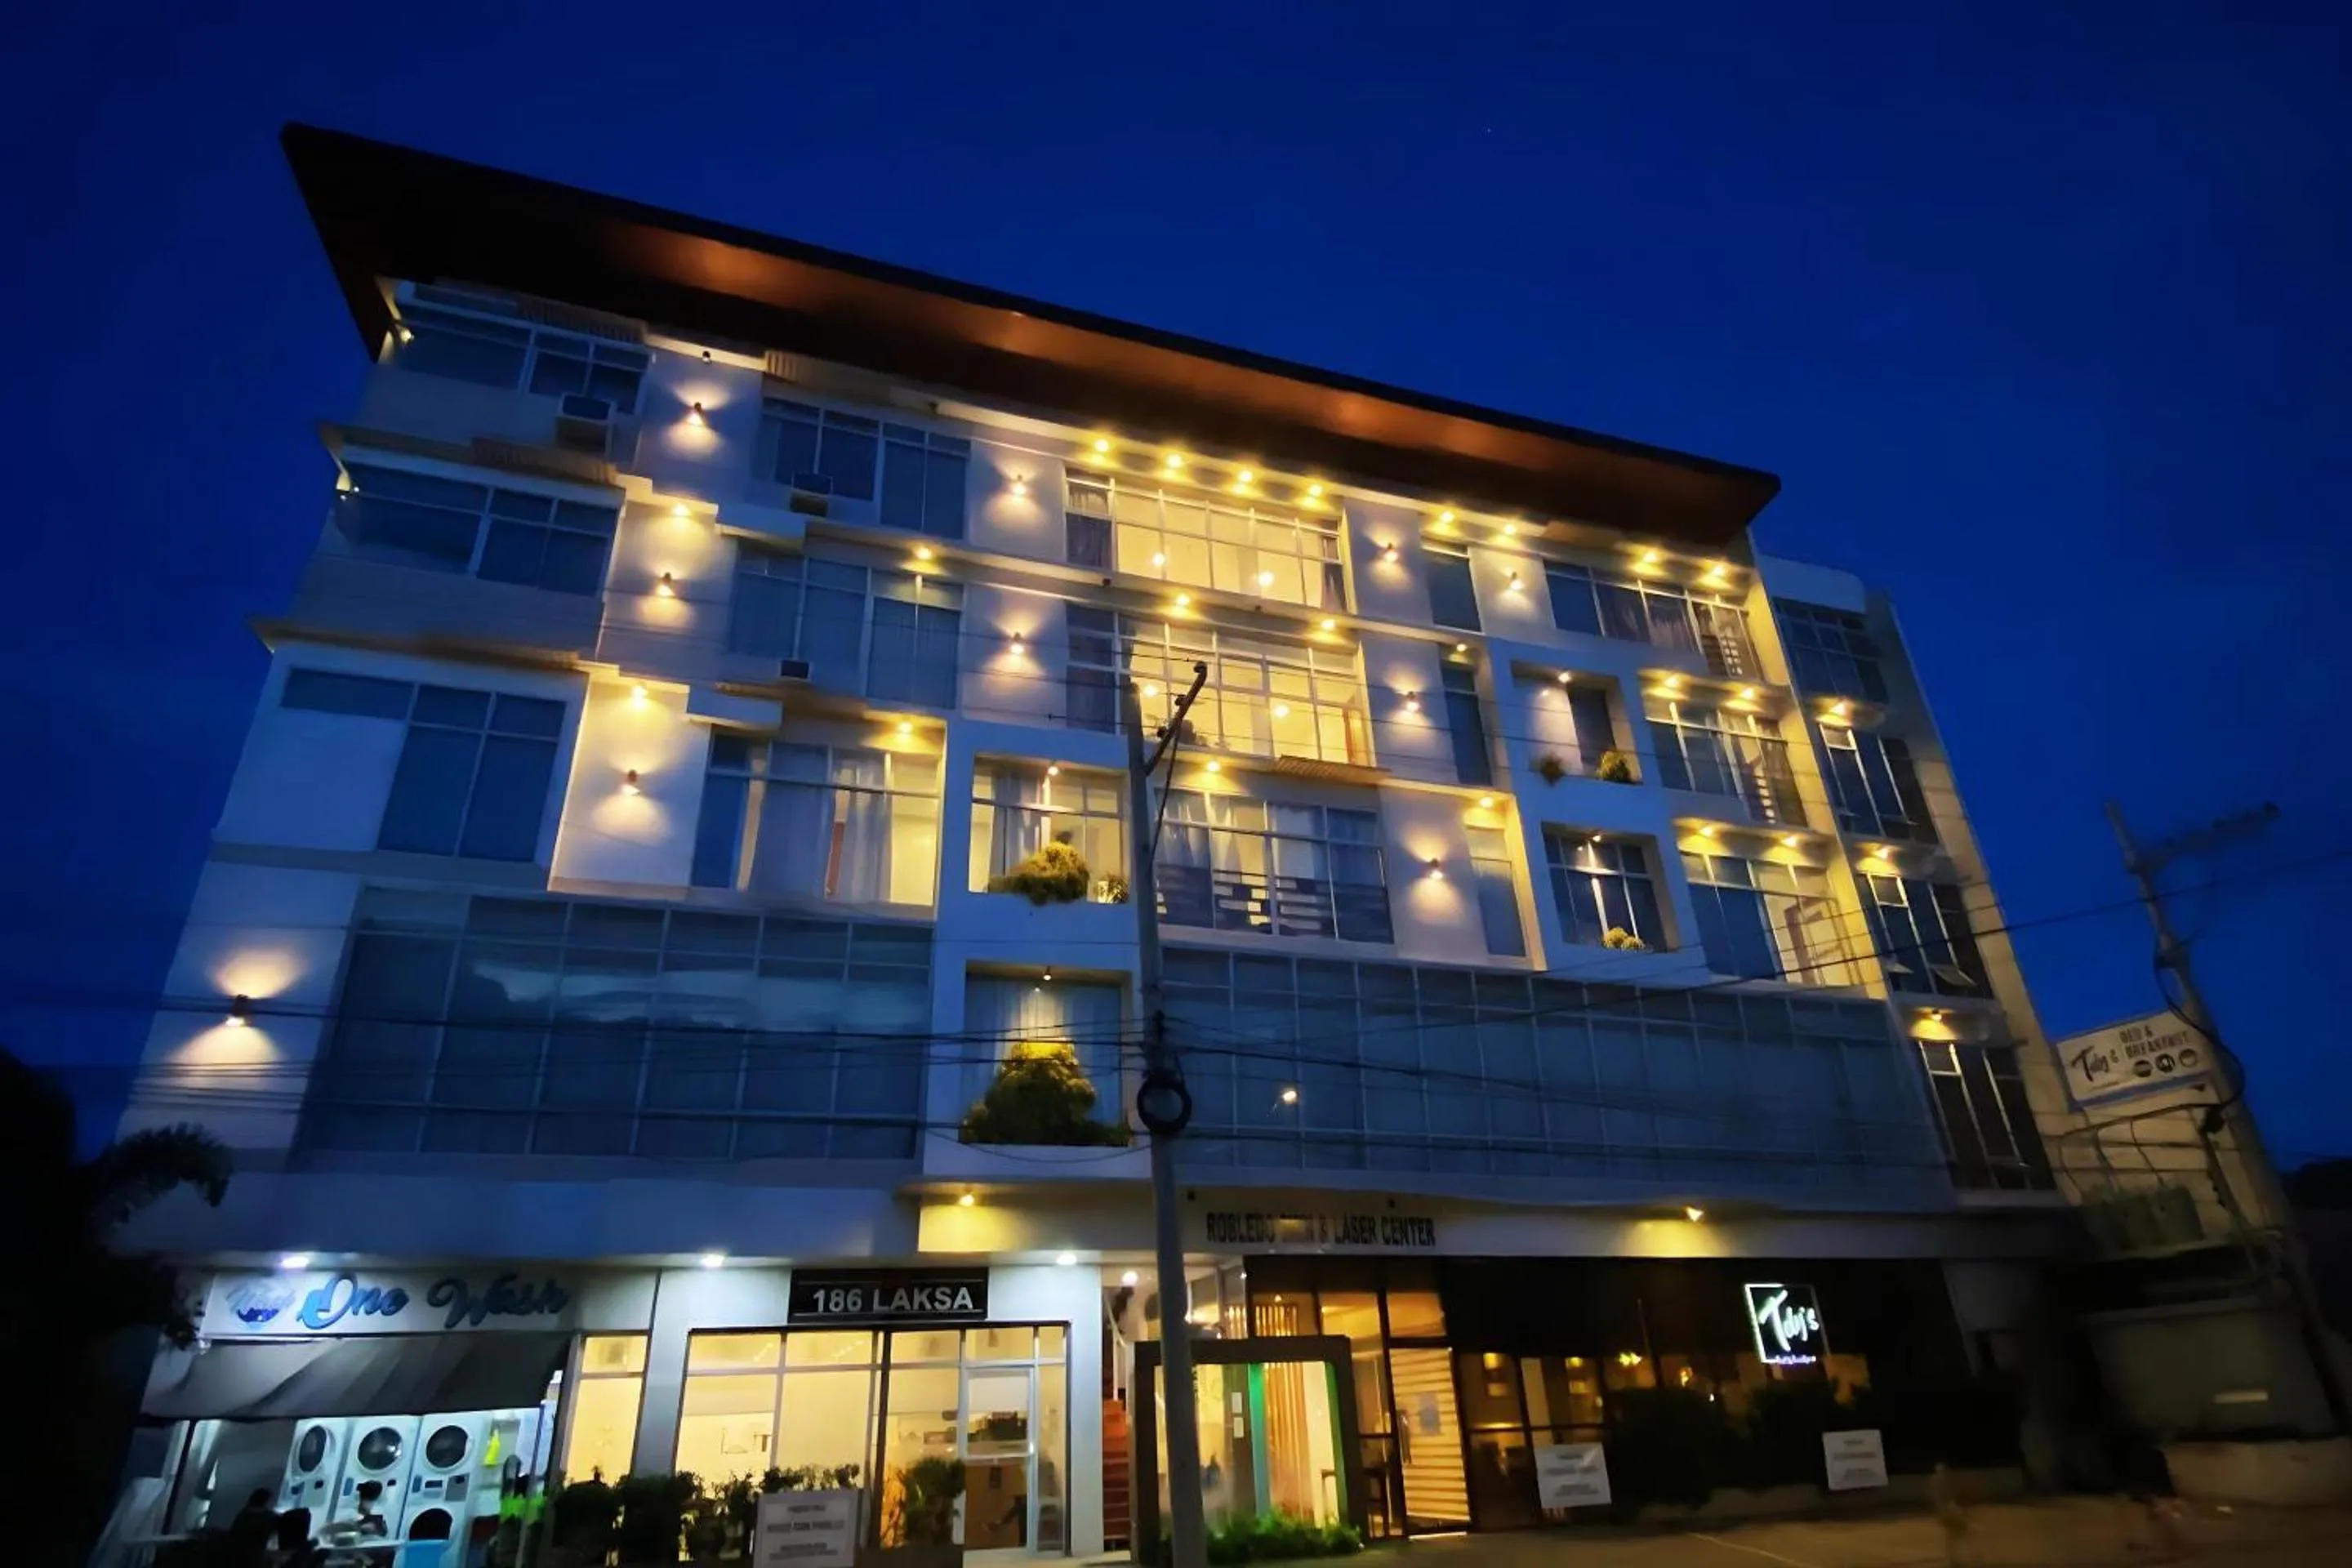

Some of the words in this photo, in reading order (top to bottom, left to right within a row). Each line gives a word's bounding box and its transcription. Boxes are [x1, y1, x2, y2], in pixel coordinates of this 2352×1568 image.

[1207, 1212, 1276, 1244] ROBLEDO
[1333, 1212, 1378, 1245] LASER
[1381, 1215, 1437, 1247] CENTER
[296, 1272, 410, 1330] One
[427, 1272, 571, 1329] Wash
[813, 1289, 862, 1313] 186
[872, 1287, 973, 1312] LAKSA
